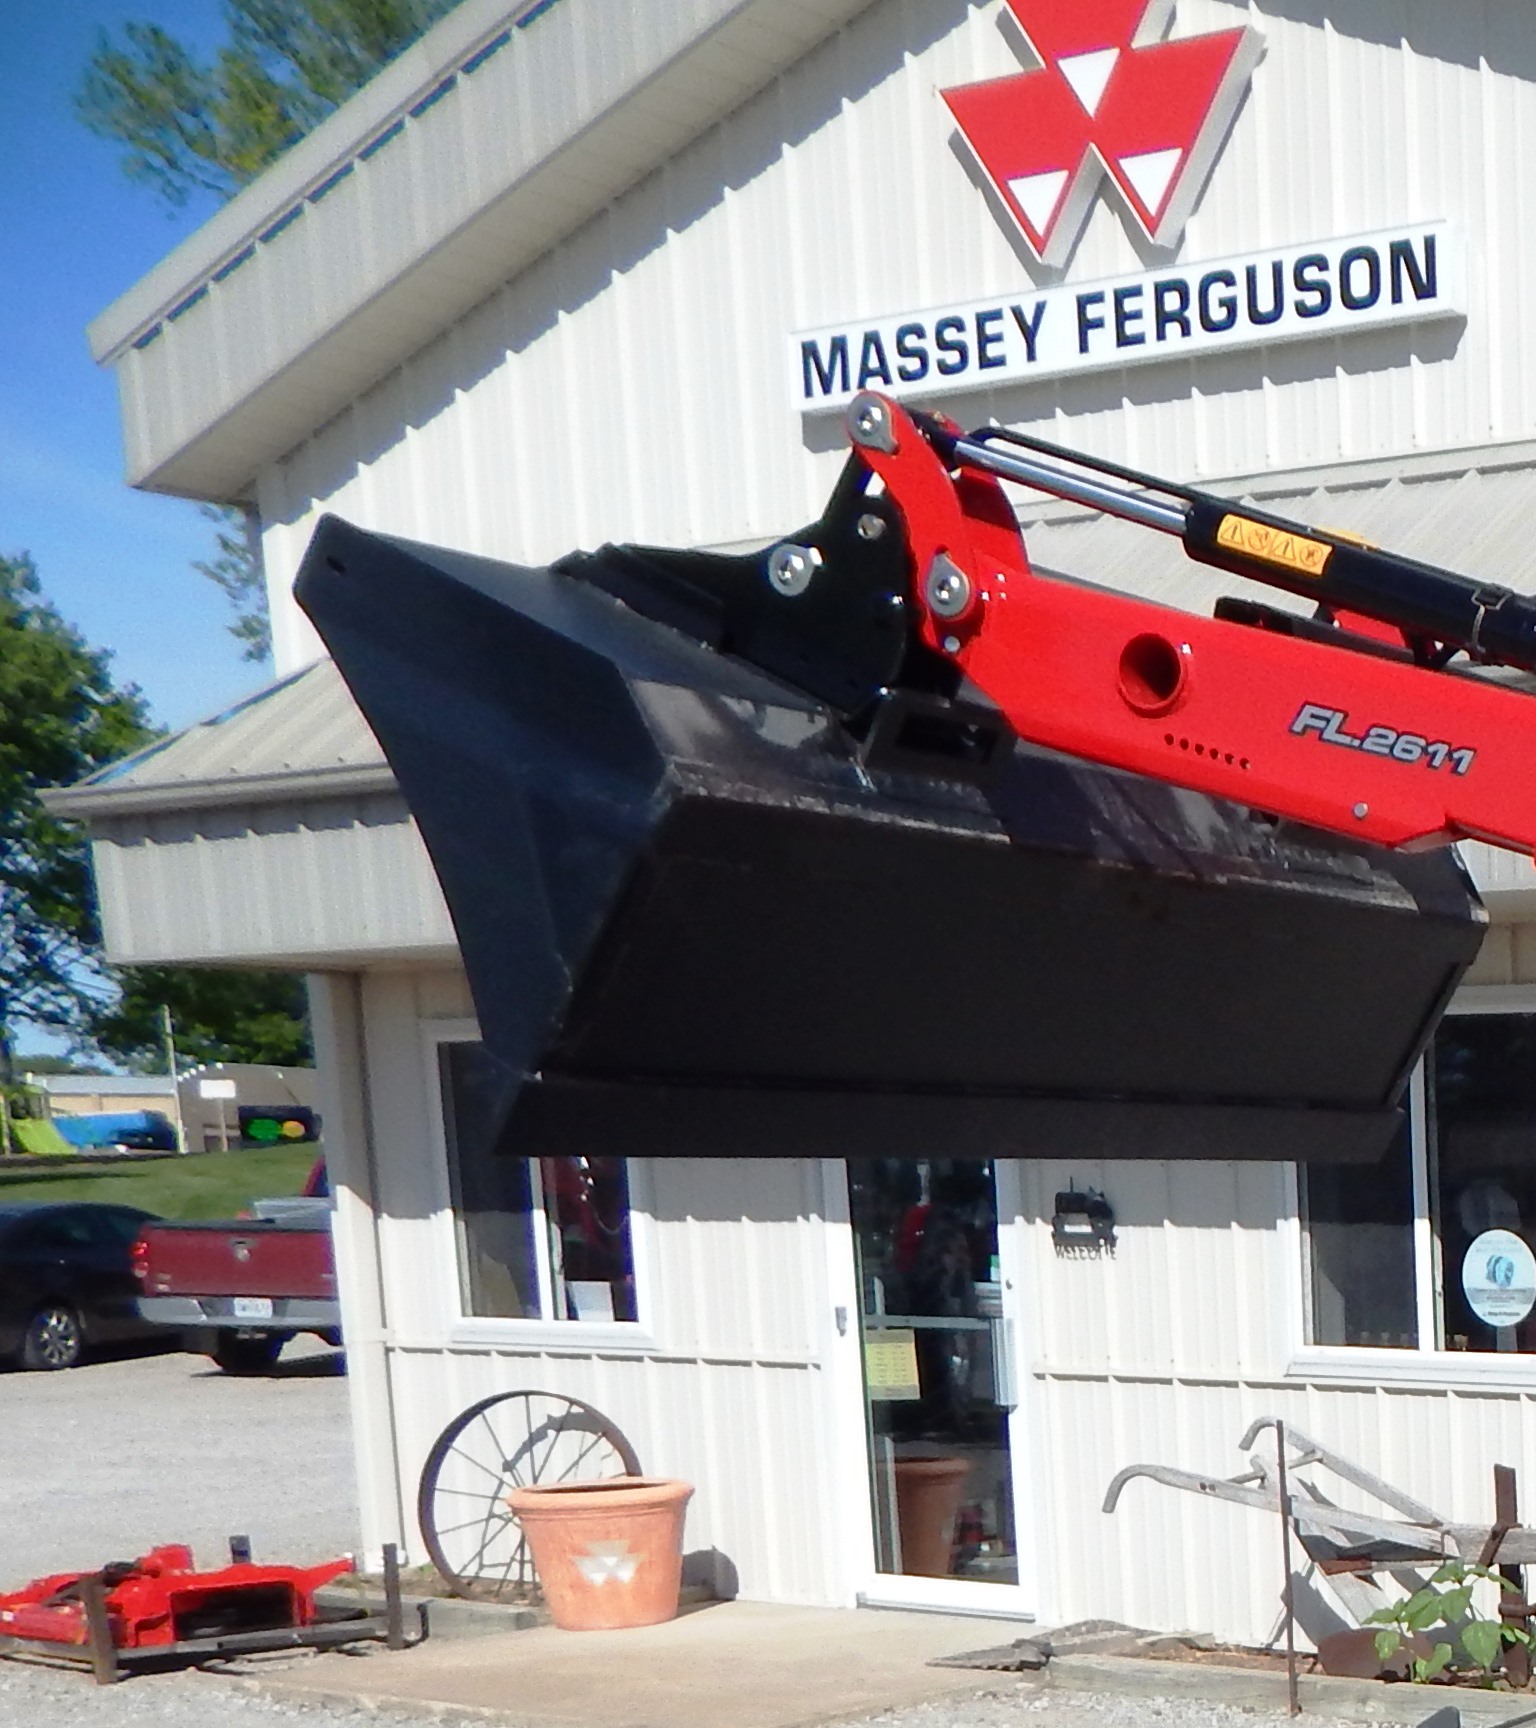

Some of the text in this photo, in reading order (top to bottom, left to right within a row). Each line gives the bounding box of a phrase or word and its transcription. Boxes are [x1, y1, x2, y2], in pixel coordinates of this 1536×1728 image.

[800, 234, 1438, 398] MASSEY FERGUSON
[1290, 701, 1476, 776] FL.2611
